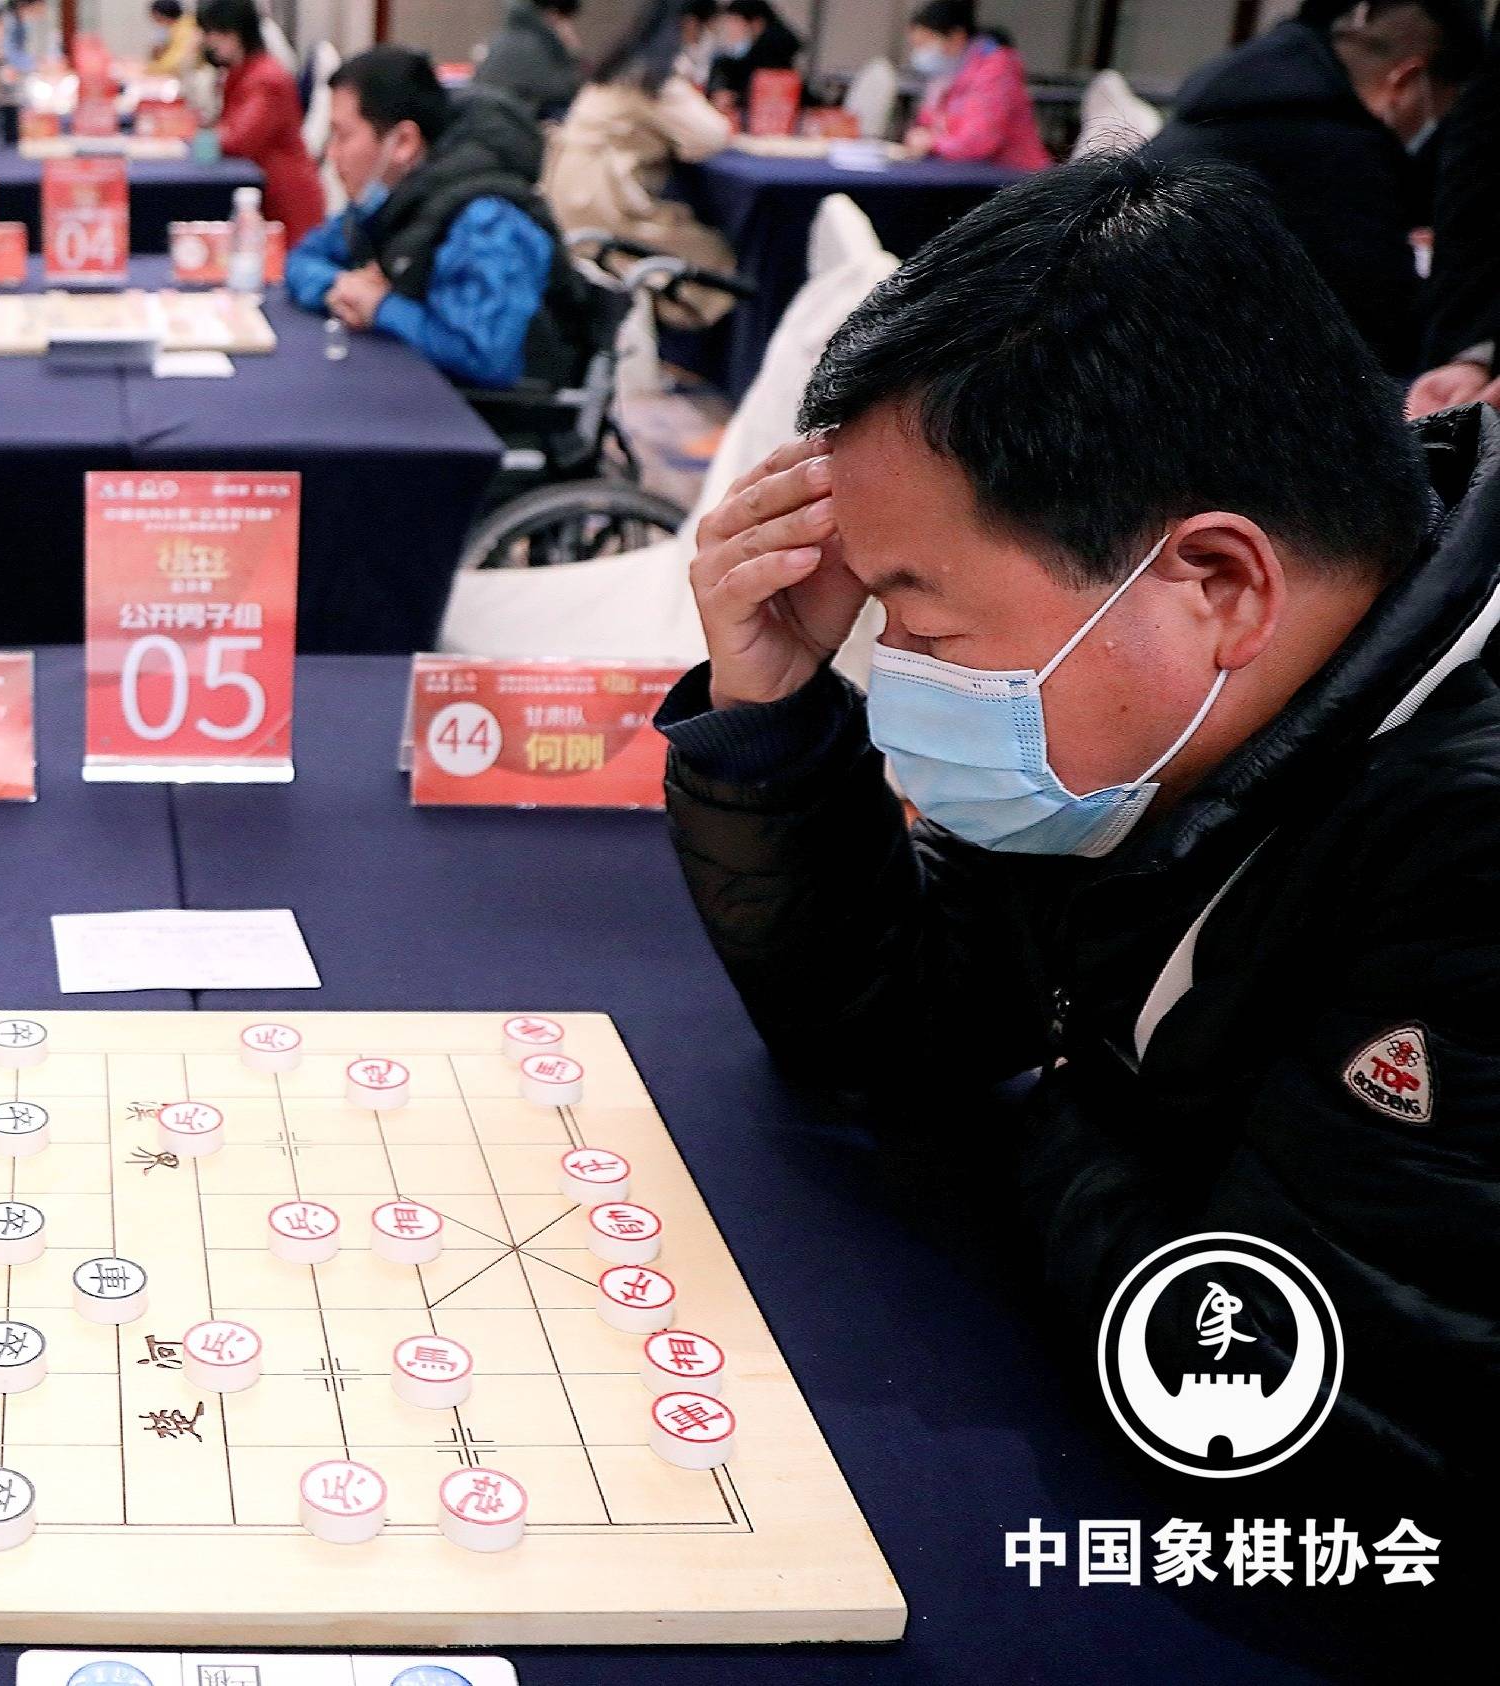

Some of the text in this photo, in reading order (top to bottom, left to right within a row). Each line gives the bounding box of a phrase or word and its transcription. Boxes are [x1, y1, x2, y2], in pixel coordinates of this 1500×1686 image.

[56, 220, 116, 270] 04
[118, 603, 263, 629] 公开男子组
[120, 634, 266, 742] 05
[436, 716, 492, 755] 44
[525, 732, 606, 771] 何刚
[0, 1023, 33, 1043] 卒
[255, 1028, 285, 1048] 兵
[1371, 1056, 1421, 1094] TOP
[1353, 1069, 1422, 1115] BOSIDENG
[175, 1107, 207, 1129] 兵
[283, 1206, 323, 1234] 兵
[392, 1207, 424, 1234] 相
[88, 1262, 130, 1292] 車
[619, 1271, 652, 1302] 仕
[200, 1328, 245, 1360] 兵
[406, 1345, 457, 1371] 馬
[668, 1337, 705, 1371] 相
[668, 1401, 725, 1435] 車
[322, 1469, 365, 1509] 兵
